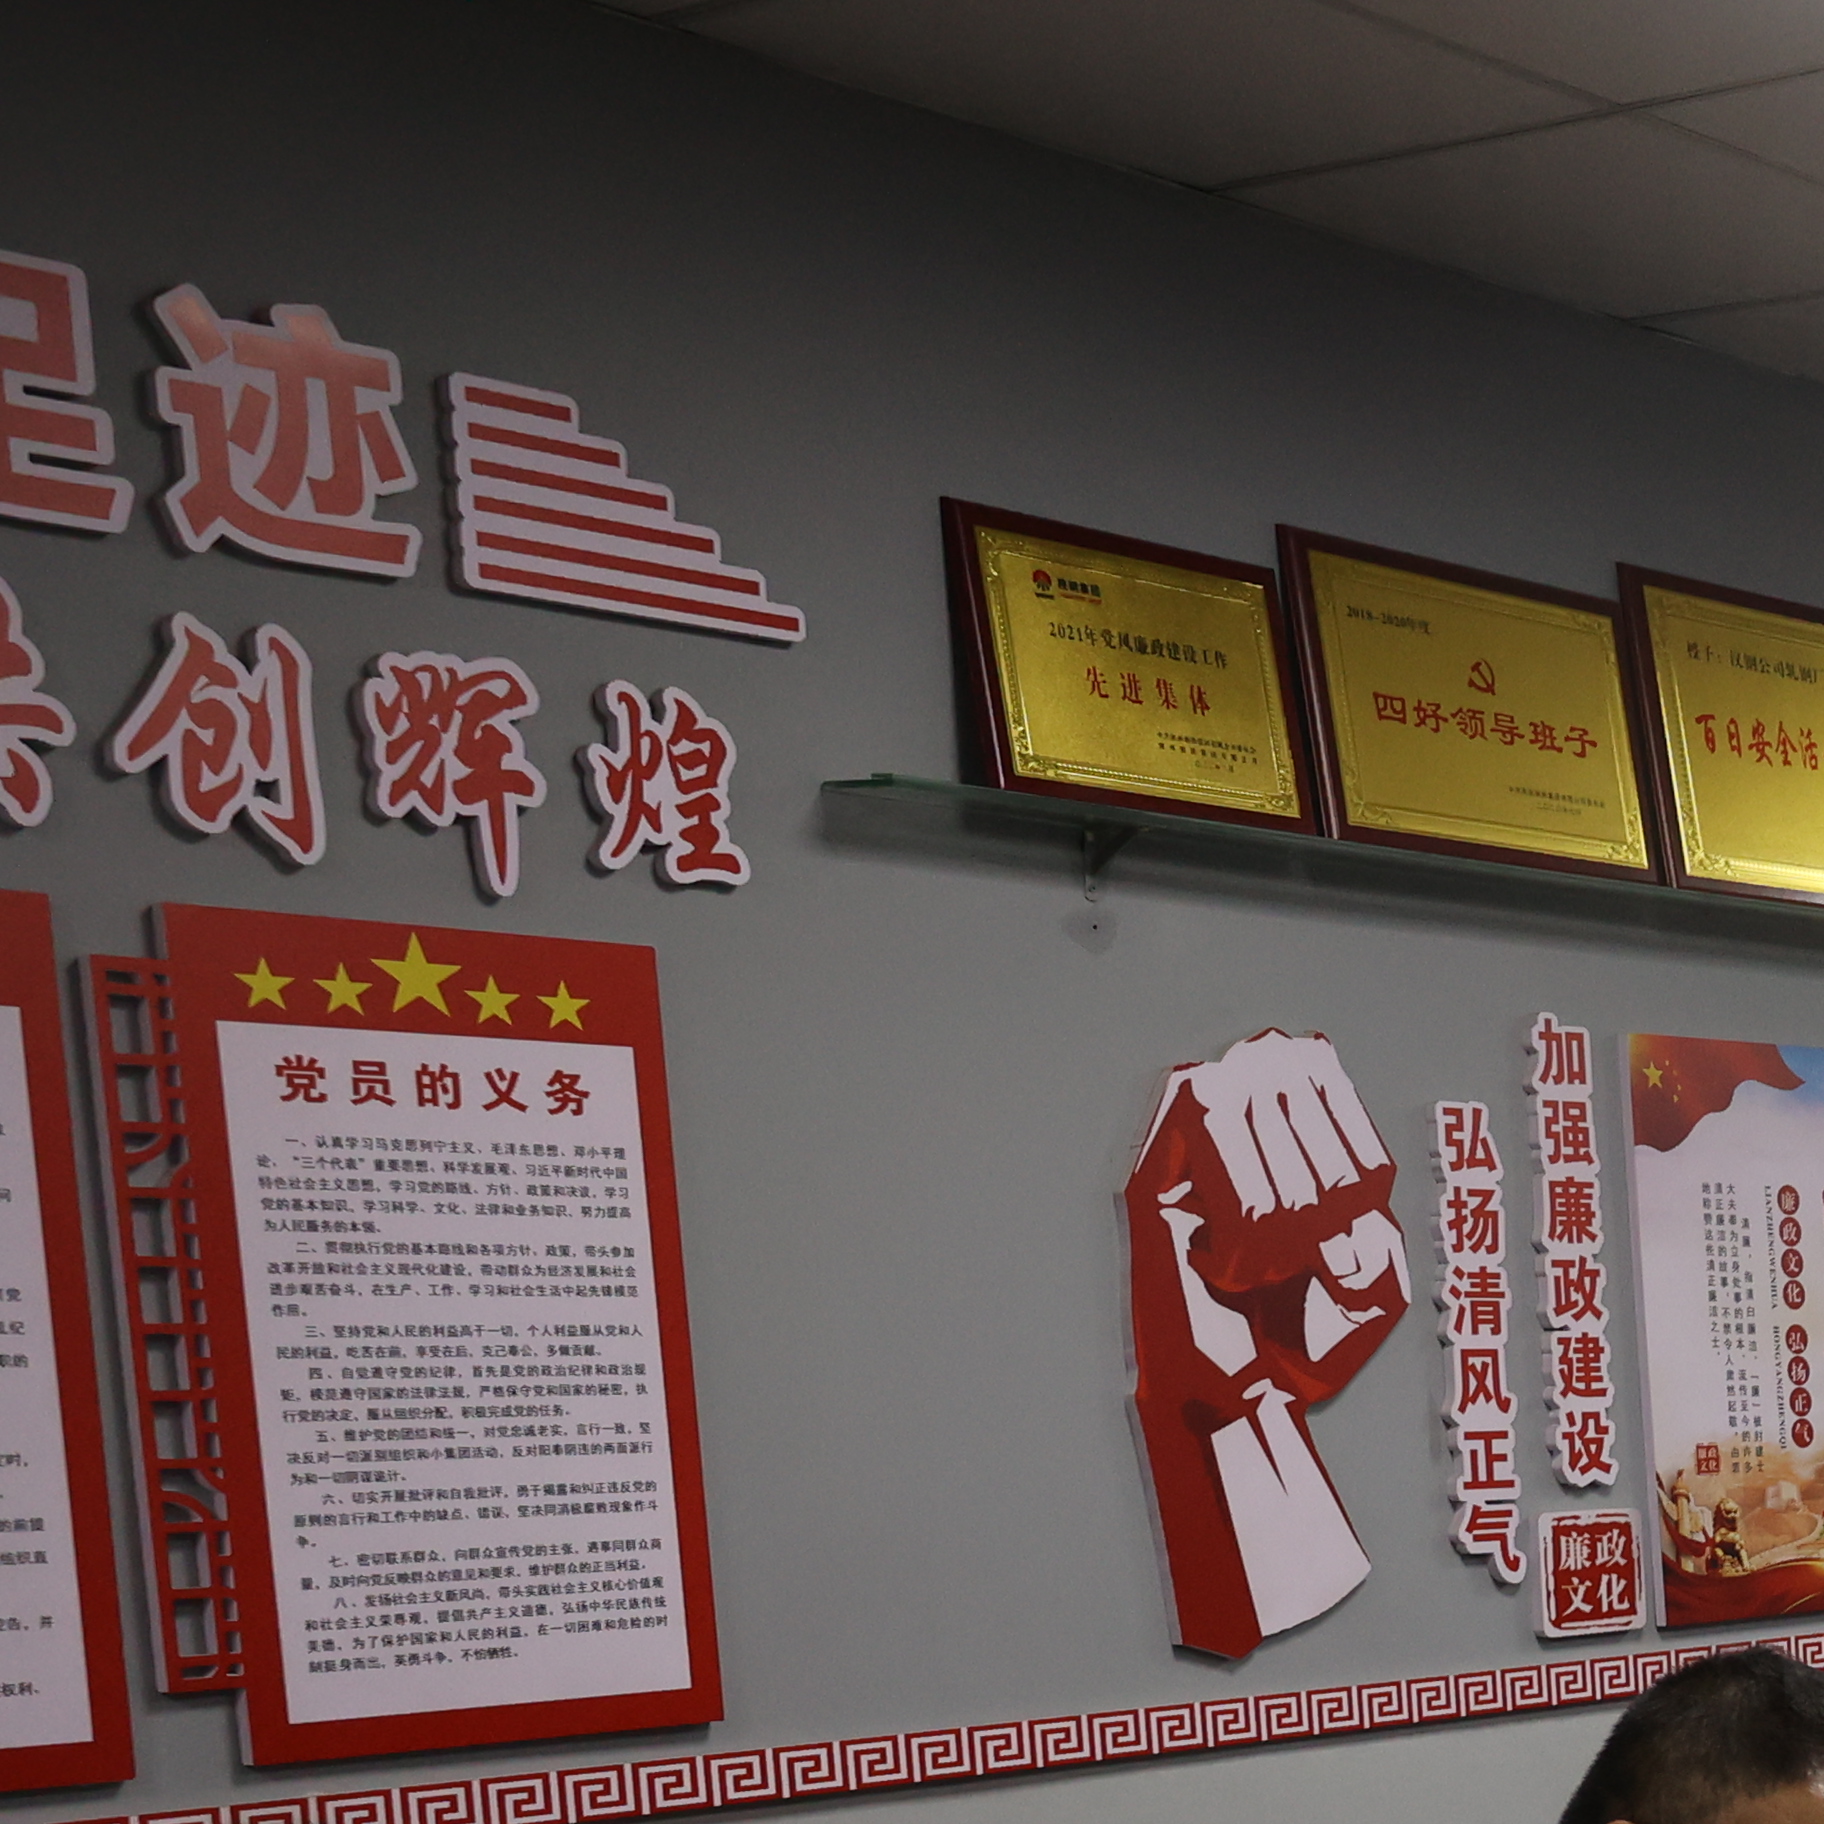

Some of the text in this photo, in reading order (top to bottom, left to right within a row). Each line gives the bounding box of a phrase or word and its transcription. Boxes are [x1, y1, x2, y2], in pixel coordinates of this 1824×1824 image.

[1086, 666, 1211, 716] 先进集体
[1373, 692, 1598, 759] 四好领导班子
[274, 1054, 591, 1116] 党员的义务
[1538, 1018, 1614, 1477] 加强廉政建设
[1778, 1187, 1804, 1308] 廉政文化
[1441, 1105, 1522, 1575] 弘扬清风正气
[1787, 1327, 1812, 1447] 弘扬正气
[1559, 1530, 1628, 1572] 廉政
[1559, 1572, 1630, 1615] 文化
